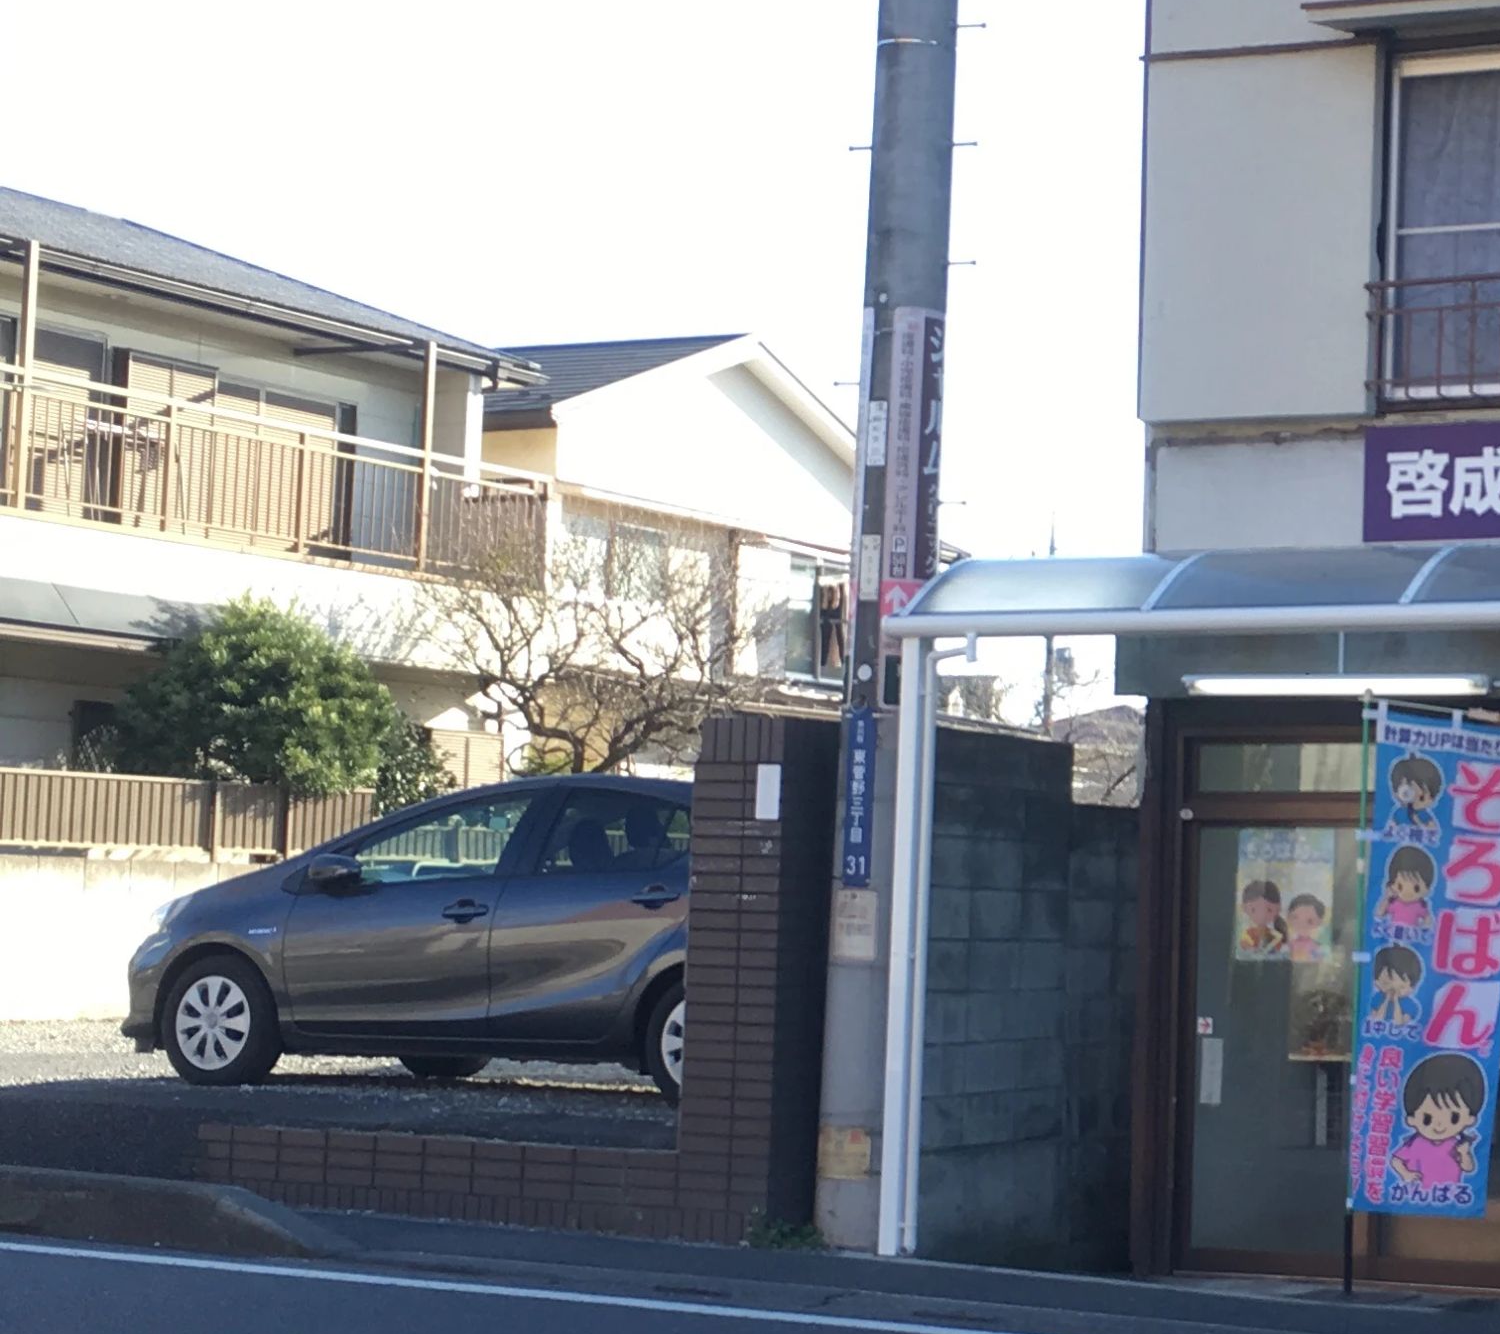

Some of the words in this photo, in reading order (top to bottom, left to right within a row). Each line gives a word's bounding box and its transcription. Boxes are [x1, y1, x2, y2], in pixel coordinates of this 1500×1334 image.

[850, 748, 867, 844] 東菅野三丁目
[846, 855, 866, 876] 31
